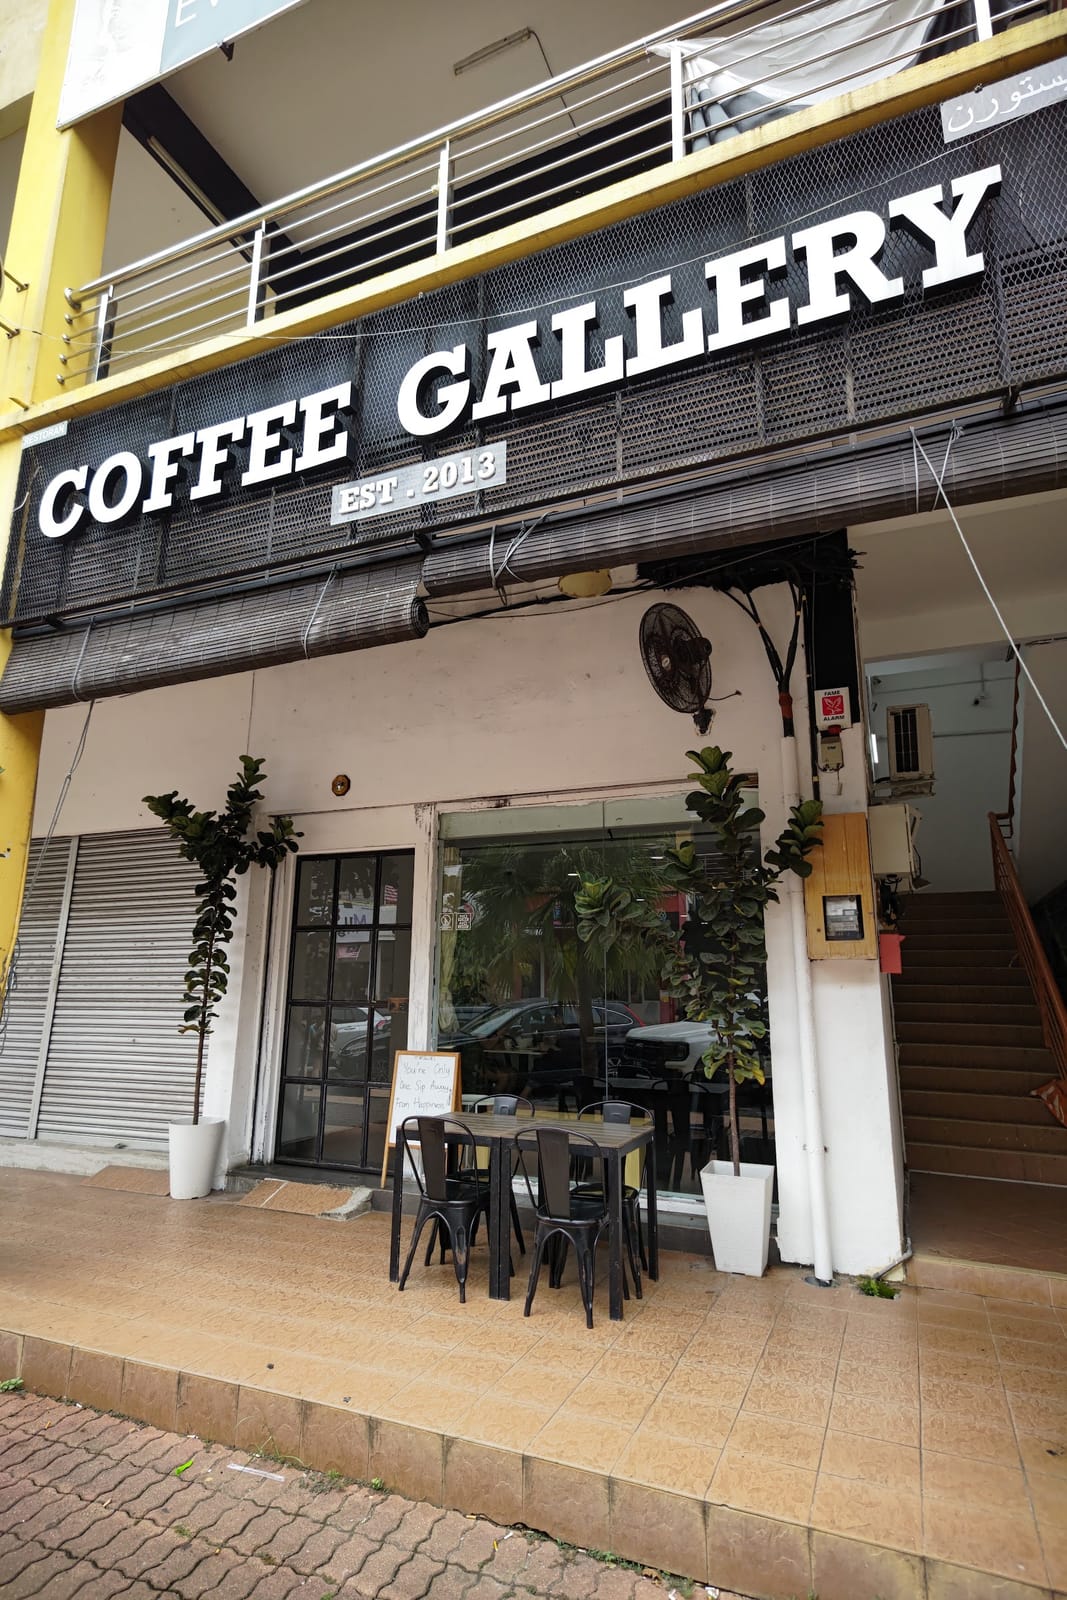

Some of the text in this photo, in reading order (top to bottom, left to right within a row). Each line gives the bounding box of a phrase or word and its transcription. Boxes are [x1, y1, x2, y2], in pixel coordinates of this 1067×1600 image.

[38, 165, 1001, 538] COFFEE GALLERY
[23, 424, 65, 447] RESTORAN
[422, 451, 496, 495] 2013
[433, 1063, 451, 1078] Only
[415, 1080, 426, 1094] Sip
